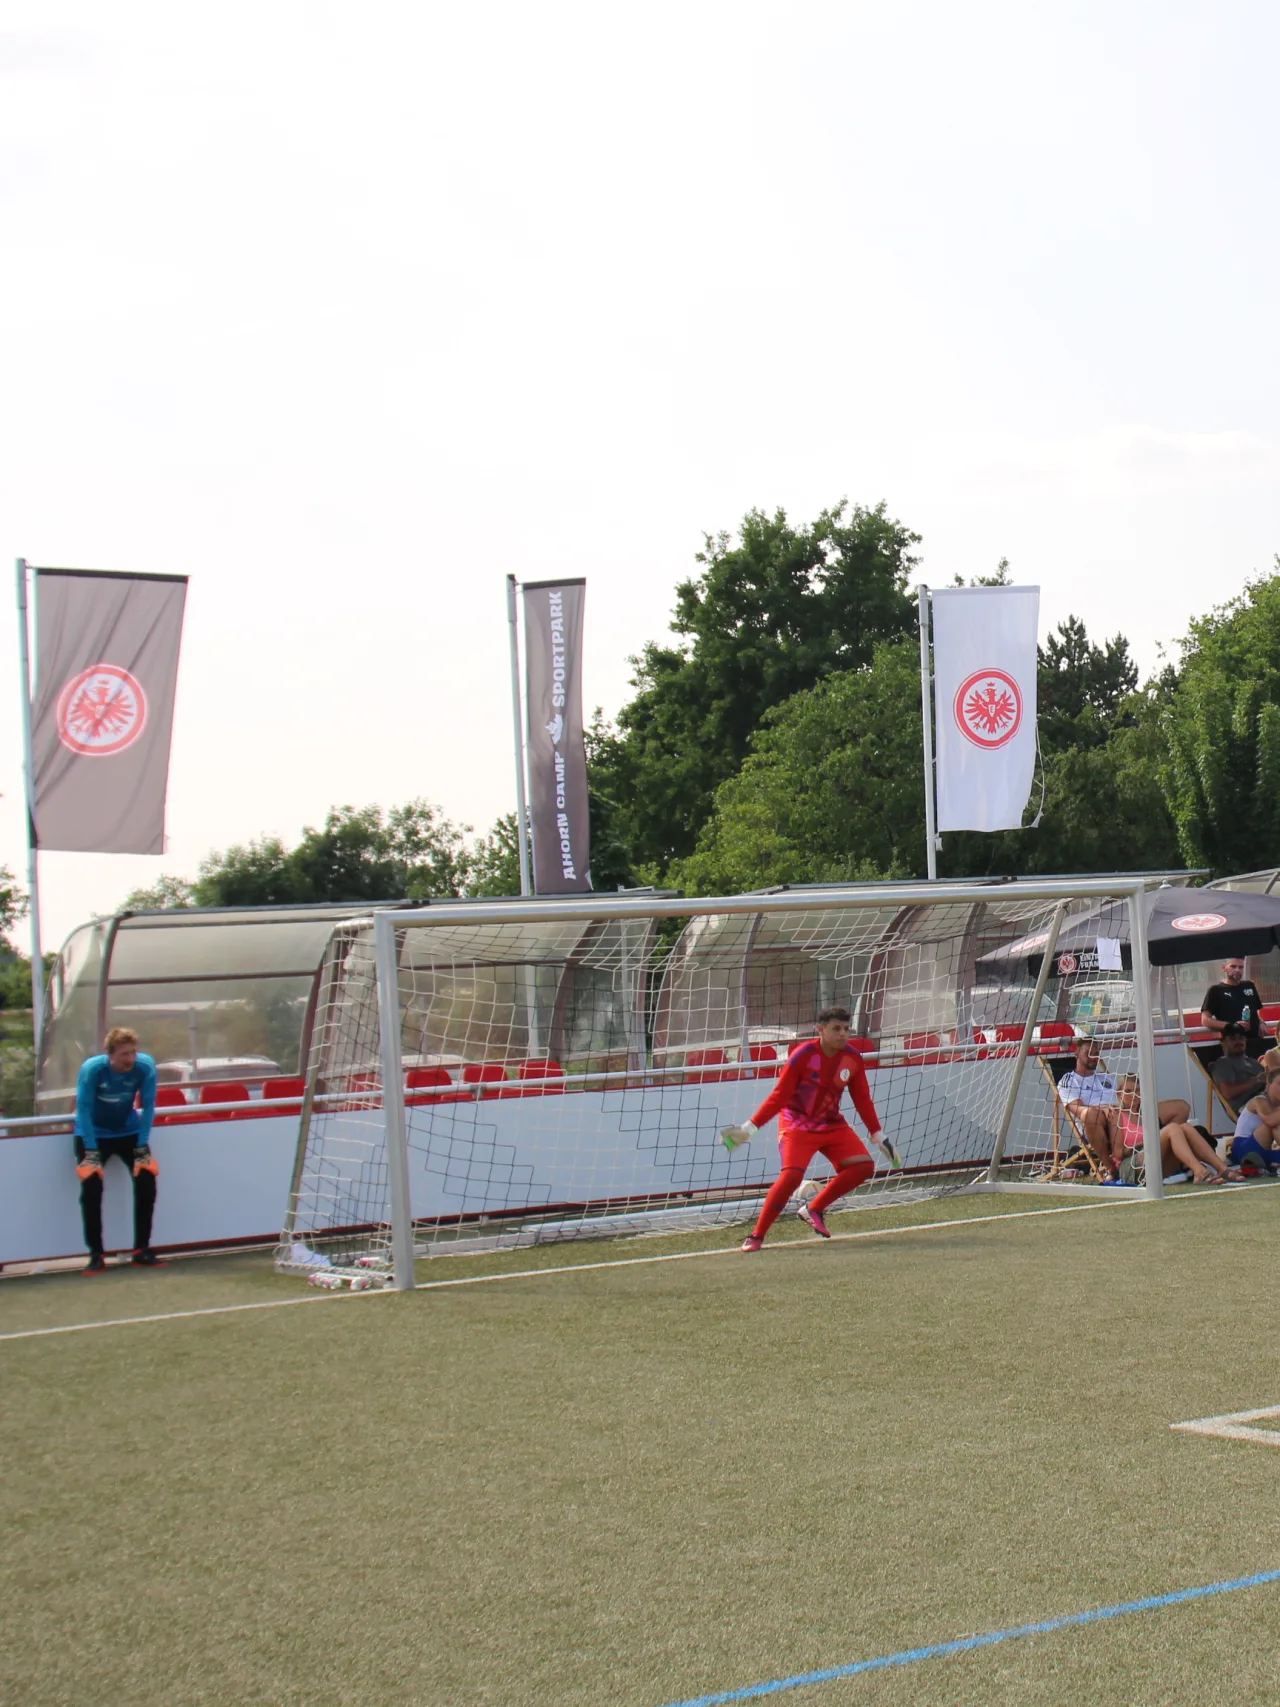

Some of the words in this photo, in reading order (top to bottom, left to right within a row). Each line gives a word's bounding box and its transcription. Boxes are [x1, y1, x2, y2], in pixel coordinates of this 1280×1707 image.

[549, 591, 565, 707] SPORTPARK
[555, 751, 565, 809] CAMP
[557, 813, 576, 880] AHORN
